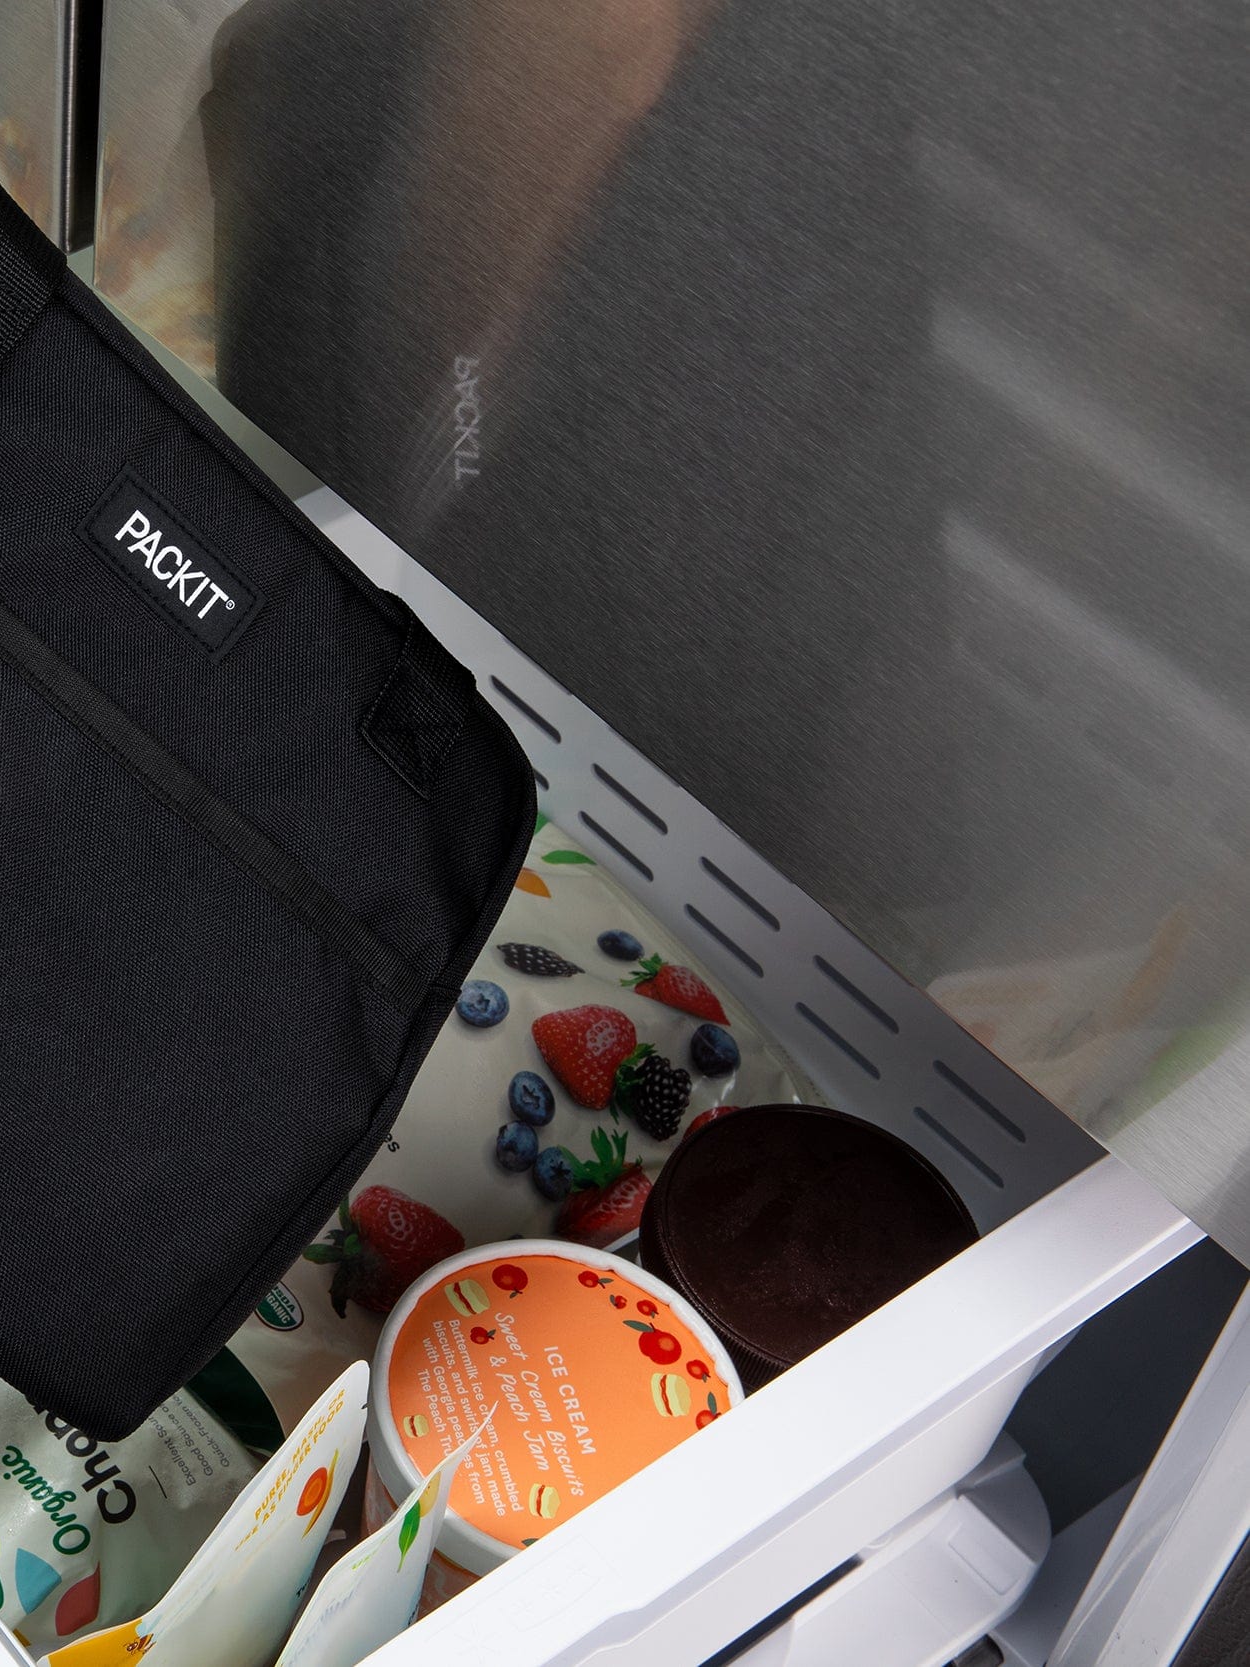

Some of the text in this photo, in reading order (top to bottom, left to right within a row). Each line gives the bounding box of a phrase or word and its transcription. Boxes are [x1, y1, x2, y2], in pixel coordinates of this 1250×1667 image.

[265, 1292, 291, 1324] GANIC
[417, 1369, 431, 1392] The
[426, 1394, 447, 1433] Peach
[451, 1372, 468, 1395] and
[494, 1312, 585, 1497] Sweet Cream Biscuits
[544, 1346, 597, 1455] ICE CREAM
[182, 1406, 230, 1467] Quick-Frozen
[313, 1400, 345, 1445] FOOD
[422, 1337, 486, 1505] with Georgia peaces from
[448, 1319, 479, 1380] Buttermilk
[471, 1382, 485, 1401] ice
[494, 1450, 524, 1512] crumbled
[461, 1398, 480, 1433] swirls
[489, 1355, 550, 1472] & Peach Jam
[164, 1437, 197, 1487] Excellent
[191, 1447, 214, 1476] Good
[475, 1436, 488, 1449] of
[475, 1451, 493, 1477] jam
[1, 1445, 91, 1556] Organic
[487, 1479, 506, 1517] made
